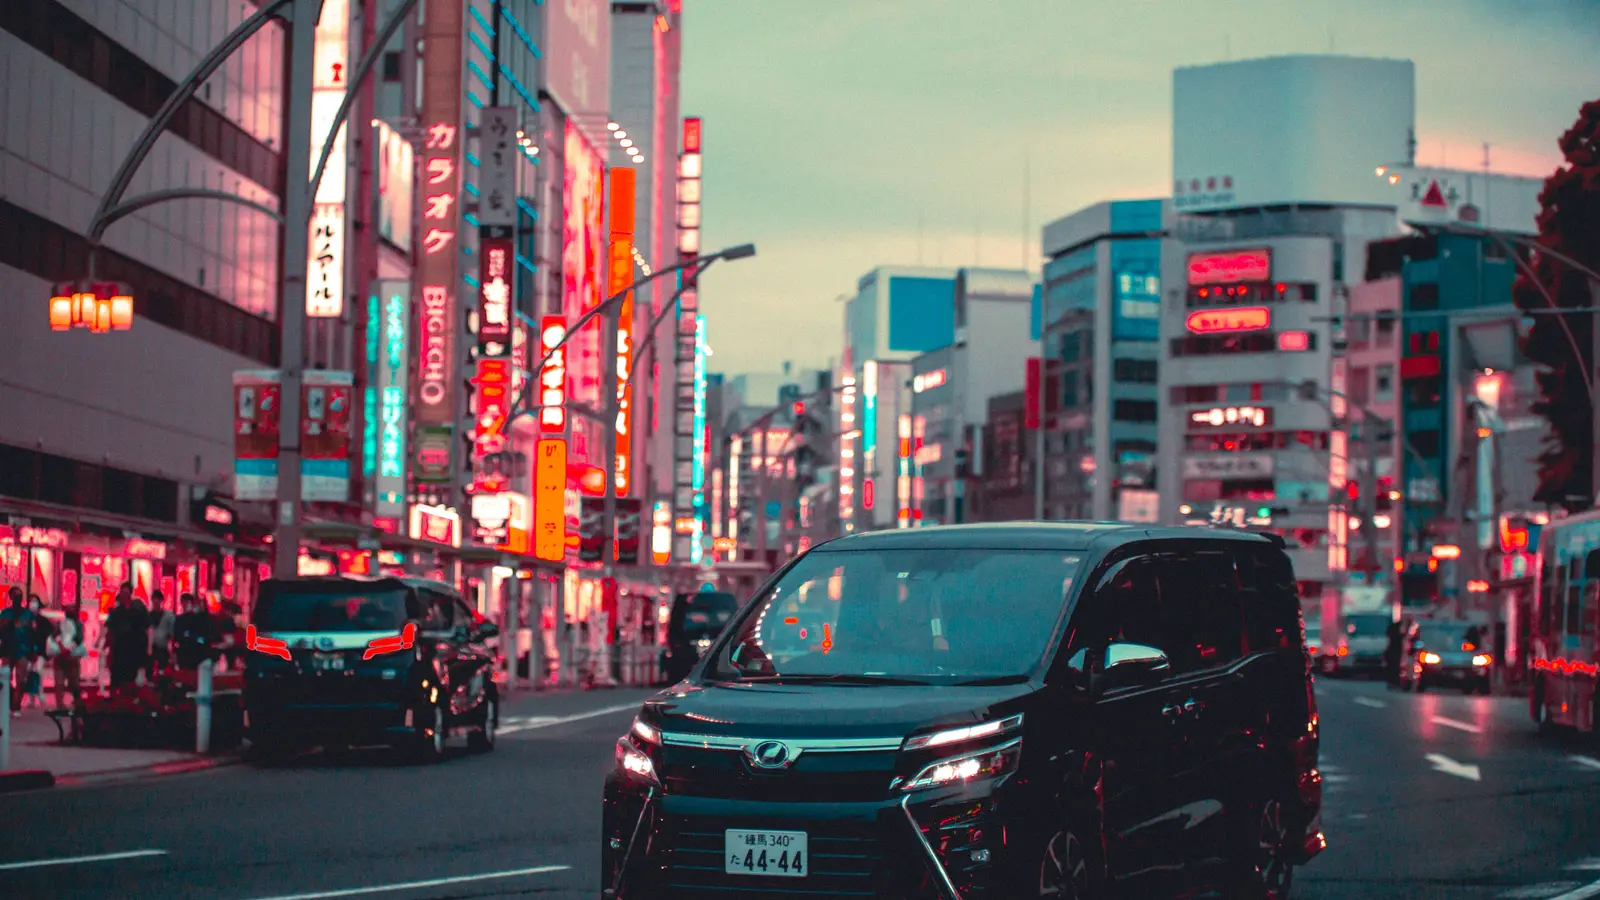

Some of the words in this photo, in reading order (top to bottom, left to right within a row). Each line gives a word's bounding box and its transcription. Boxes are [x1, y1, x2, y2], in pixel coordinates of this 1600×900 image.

[423, 123, 455, 254] カラオケ
[315, 225, 335, 299] ルノアール
[744, 848, 802, 873] 44-44
